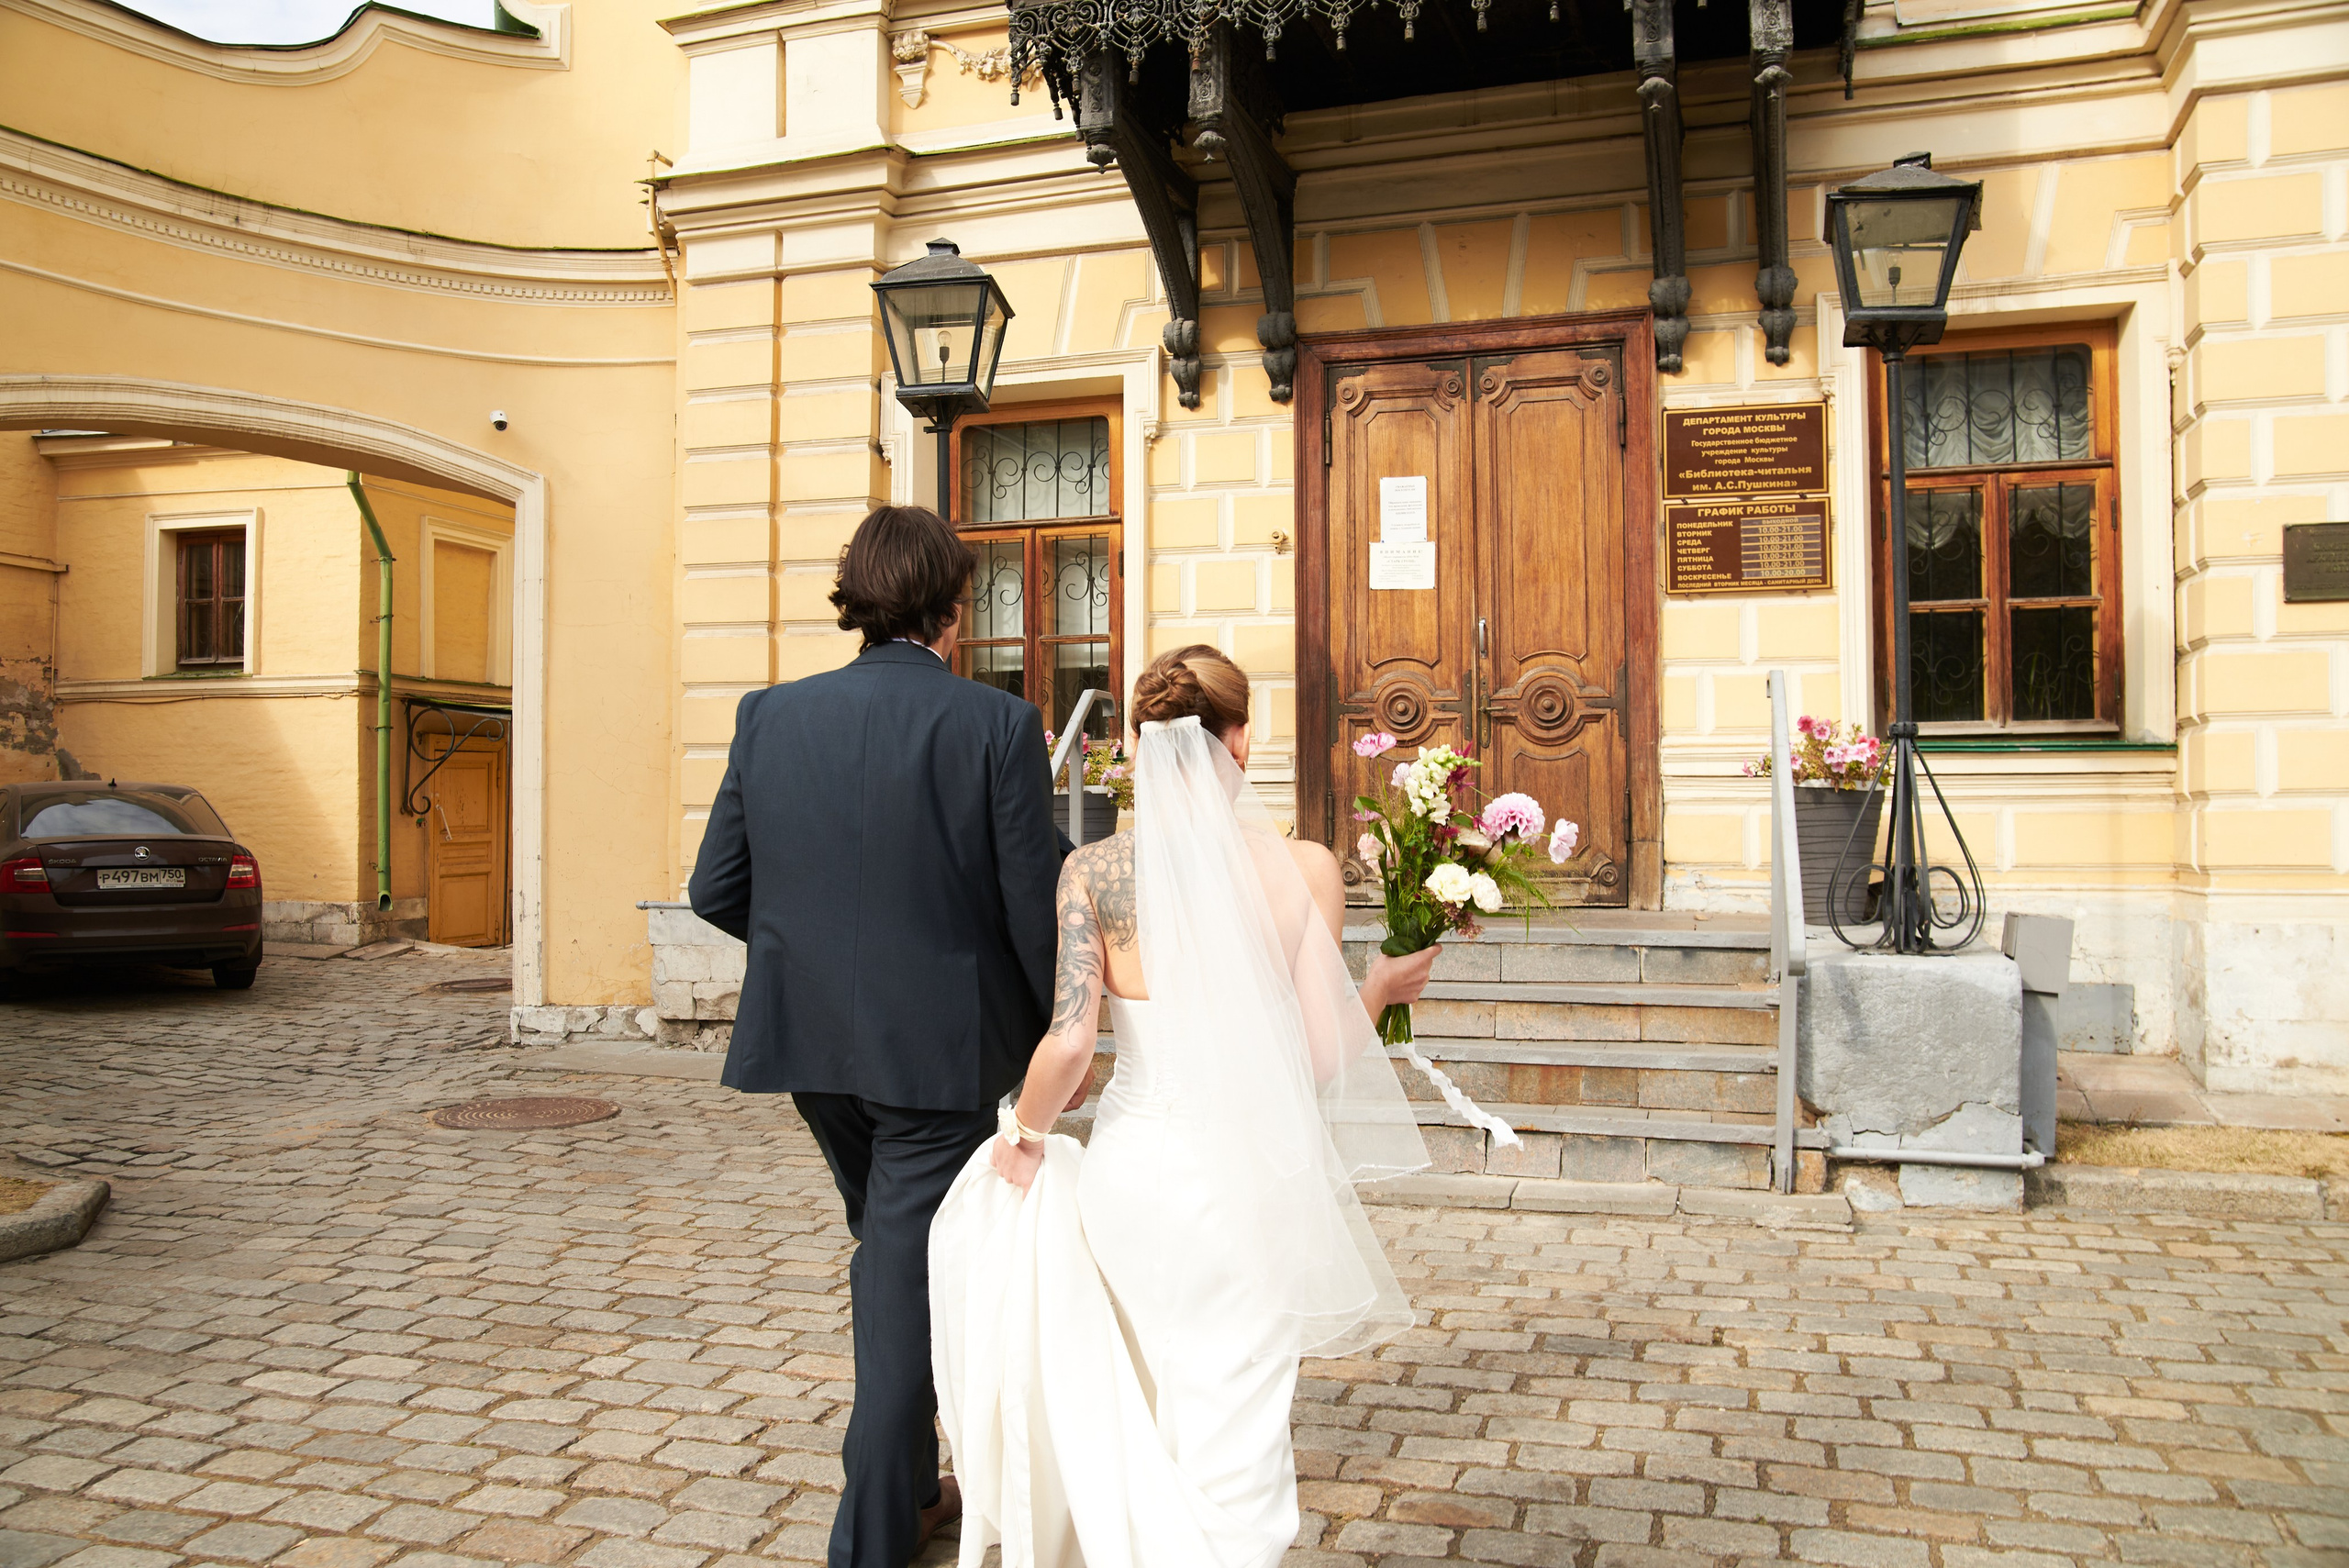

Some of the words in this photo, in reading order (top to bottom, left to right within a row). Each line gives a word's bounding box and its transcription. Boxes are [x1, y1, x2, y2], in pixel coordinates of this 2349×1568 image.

[1683, 415, 1753, 427] ДЕПАРТАМЕНТ
[1755, 412, 1806, 422] КУЛЬТУРЫ
[1703, 427, 1742, 436] ГОРОДА
[1743, 424, 1786, 434] МОСКВЫ
[1691, 438, 1753, 448] Государственное
[1754, 436, 1798, 444] бюджетное
[1701, 448, 1747, 457] учреждение
[1751, 446, 1788, 454] культуры
[1744, 456, 1775, 464] Москвы
[1678, 466, 1812, 479] «Библиотека-читальня
[1692, 484, 1712, 492] им.
[1715, 480, 1798, 491] А.С.Пушкина»
[1698, 506, 1743, 517] ГРАФИК
[1747, 505, 1796, 515] РАБОТЫ
[1676, 521, 1733, 529] ПОНЕДЕЛЬНИК
[1758, 526, 1803, 534] 10.00-21.00
[1759, 543, 1804, 551] 10.00-21.00
[1761, 569, 1806, 577] 10.00-20.00
[161, 869, 182, 879] 750
